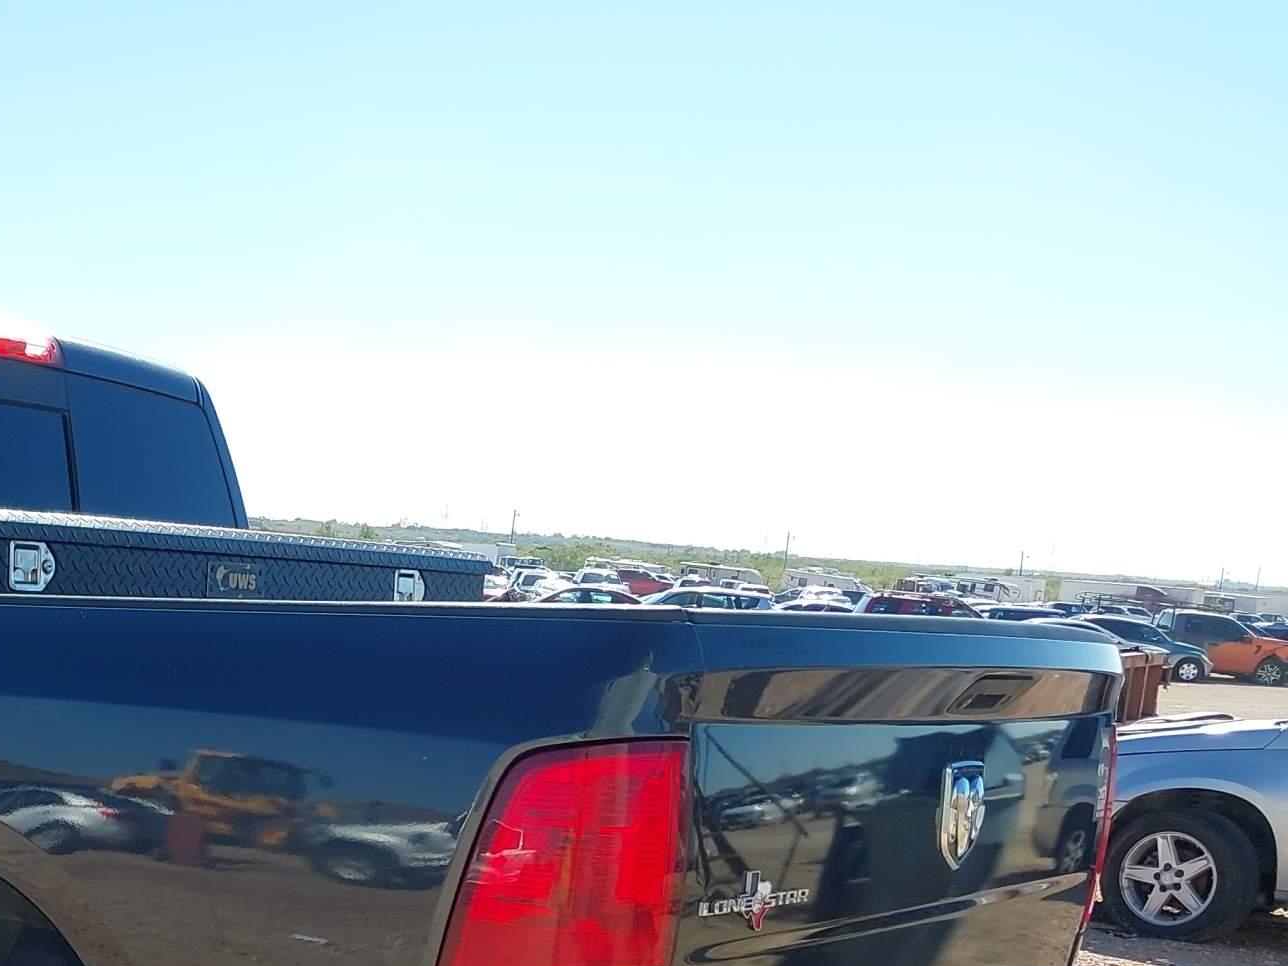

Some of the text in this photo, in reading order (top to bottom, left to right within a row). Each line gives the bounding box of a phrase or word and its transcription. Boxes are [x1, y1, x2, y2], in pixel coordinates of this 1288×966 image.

[229, 572, 257, 590] UWS
[698, 888, 810, 917] LONE STAR
